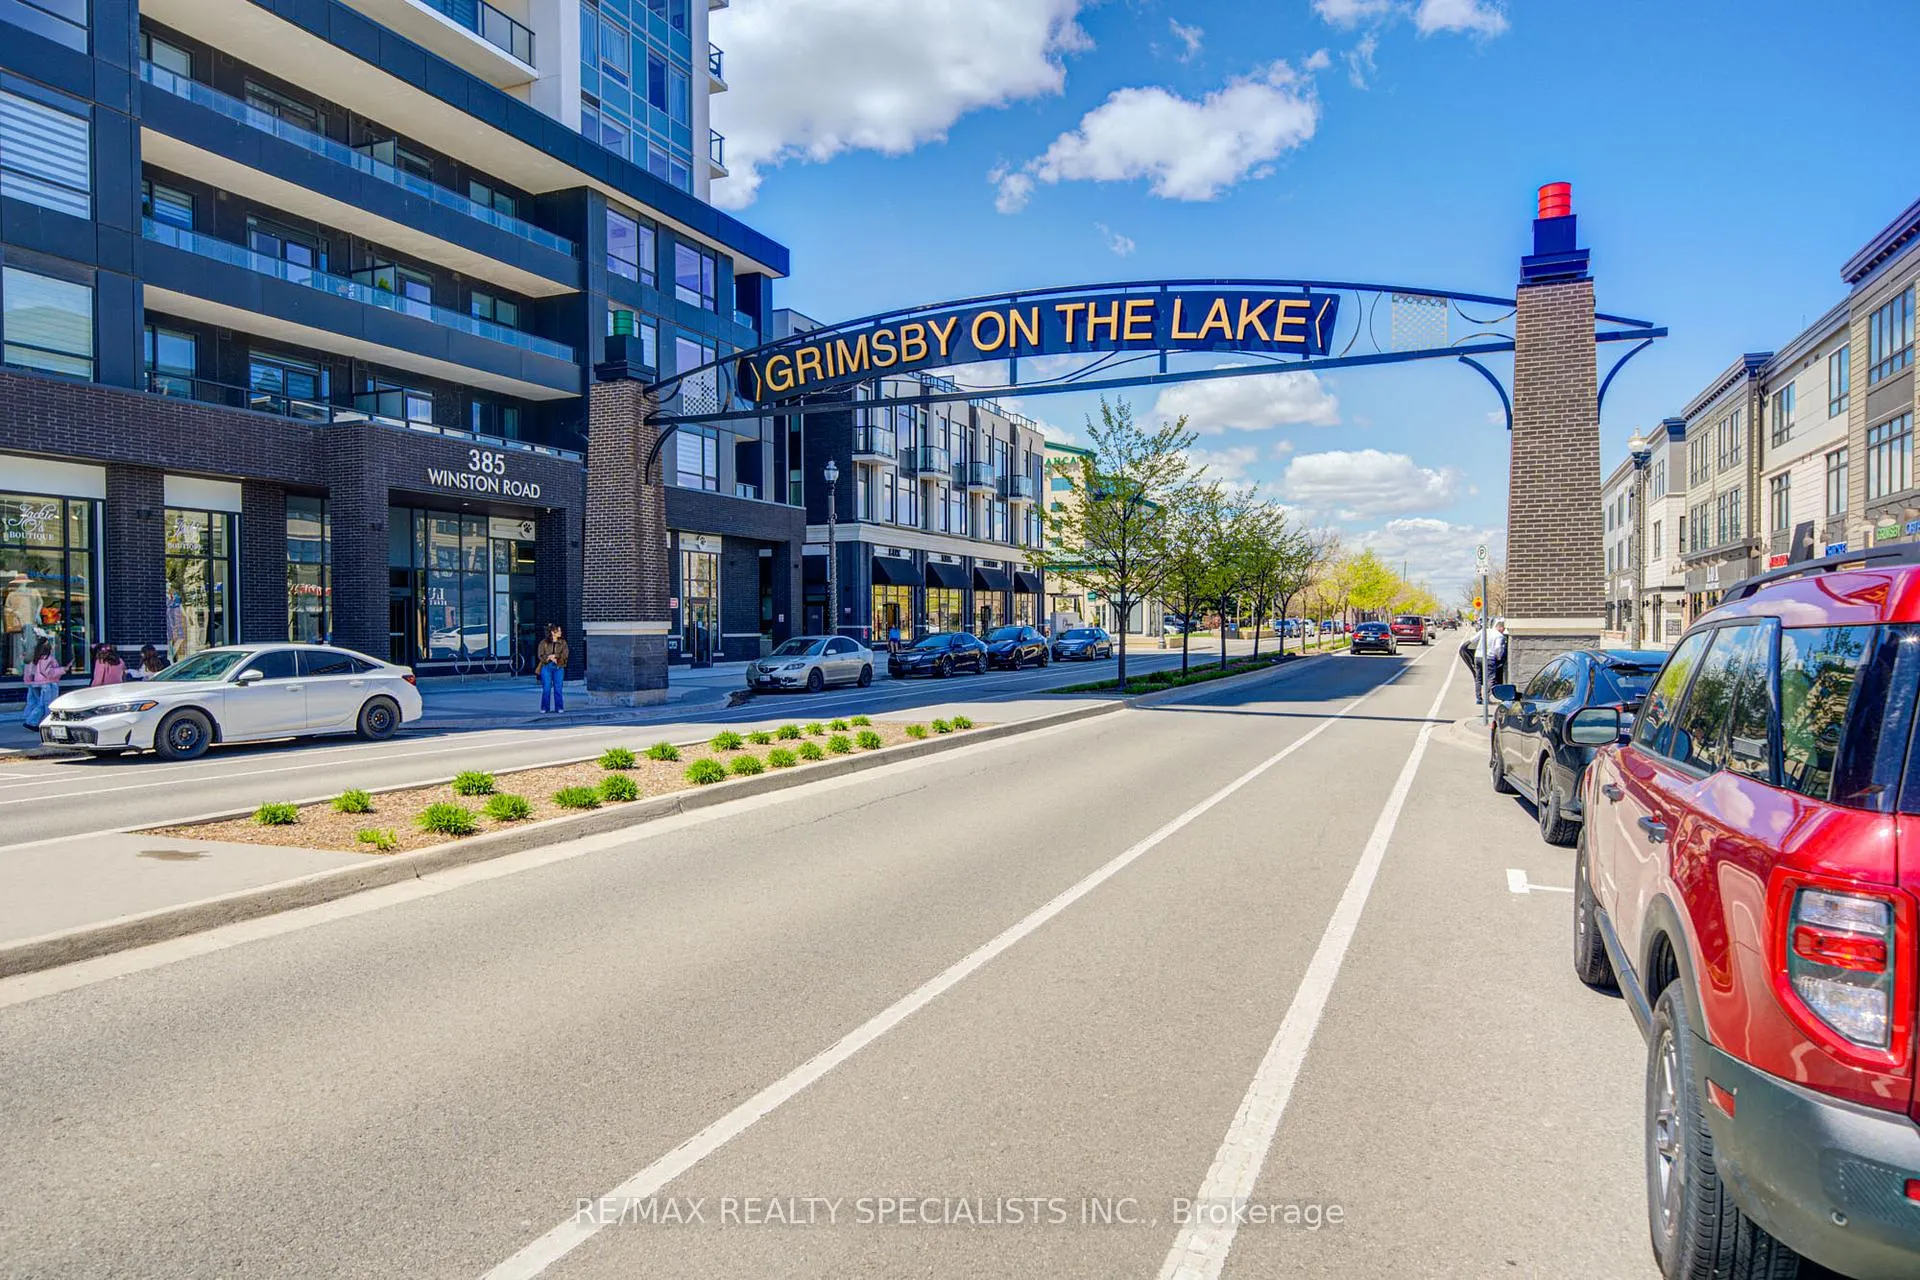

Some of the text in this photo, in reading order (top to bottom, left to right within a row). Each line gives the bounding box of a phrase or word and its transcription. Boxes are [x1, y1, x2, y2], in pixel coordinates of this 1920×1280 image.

[764, 297, 1311, 393] GRIMSBY ON THE LAKE
[468, 448, 506, 475] 385
[427, 467, 541, 499] WINSTON ROAD
[9, 531, 55, 541] BOUTIQUE
